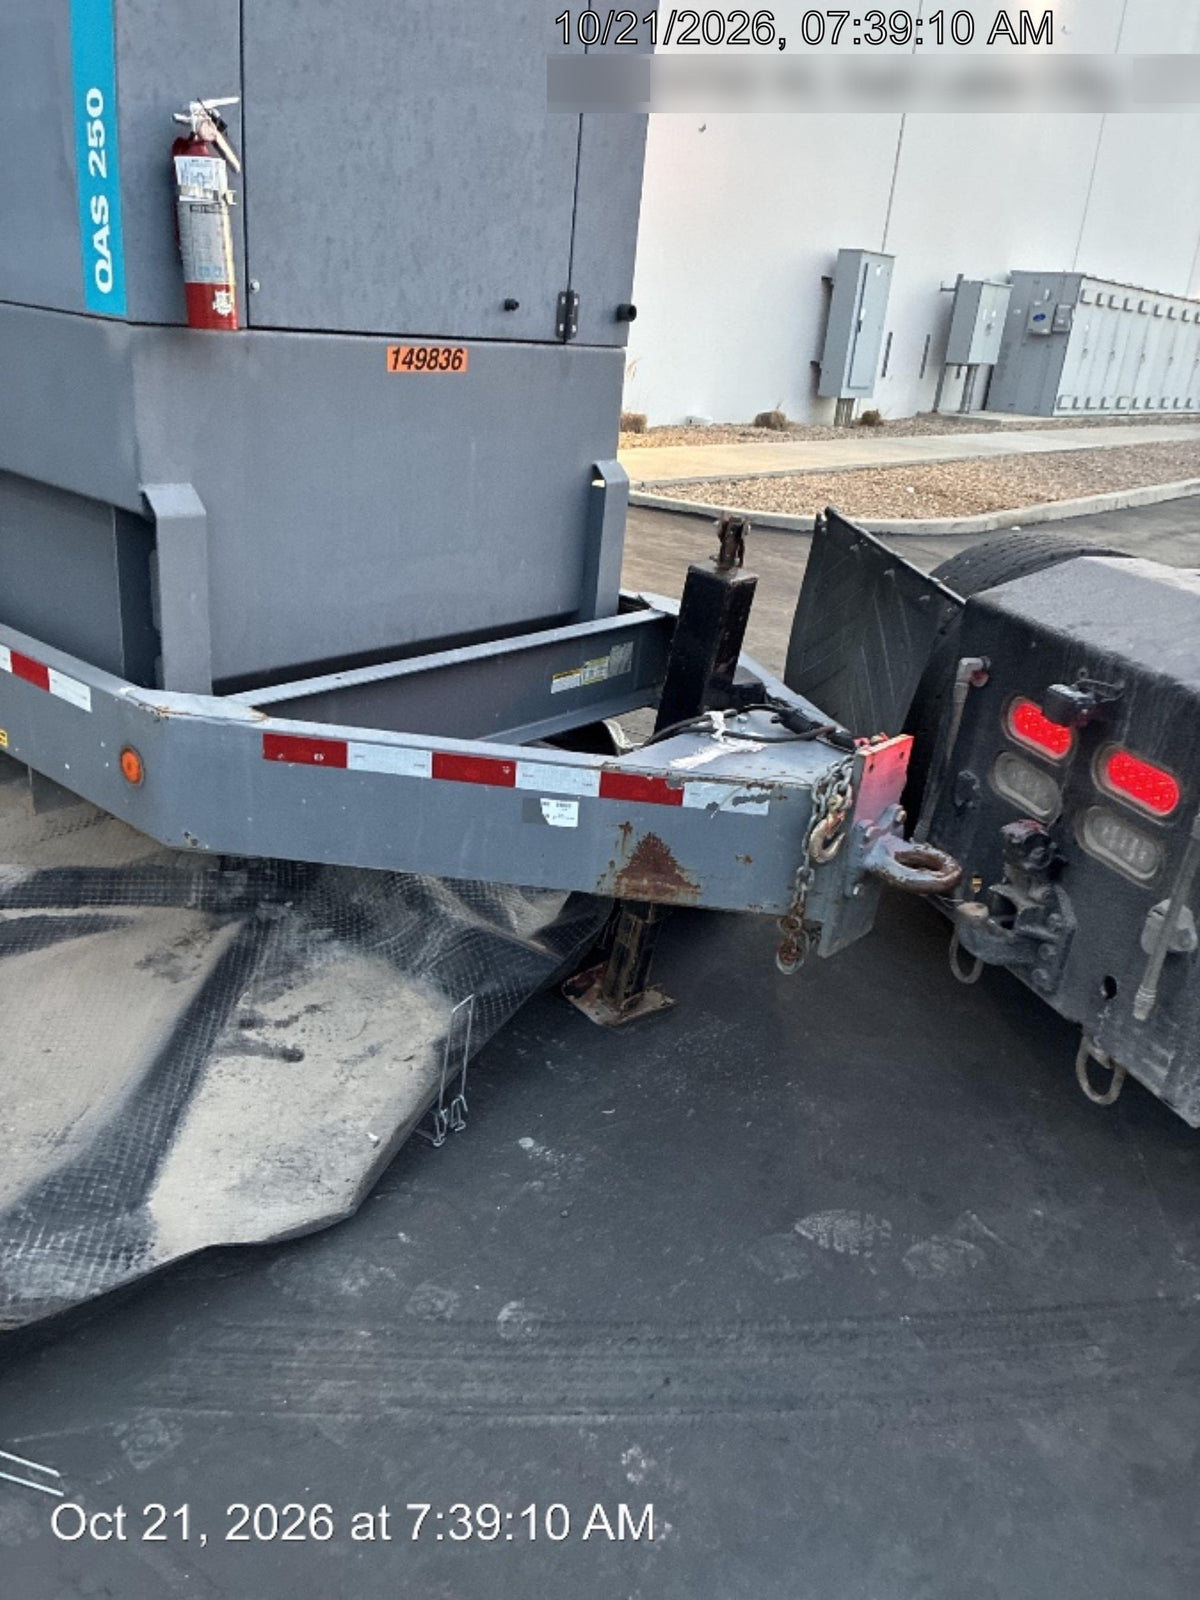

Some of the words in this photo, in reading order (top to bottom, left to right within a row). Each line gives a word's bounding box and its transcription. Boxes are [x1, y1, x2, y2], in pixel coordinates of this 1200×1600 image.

[86, 87, 108, 179] 250
[90, 195, 114, 294] QAS
[391, 346, 465, 370] 149836
